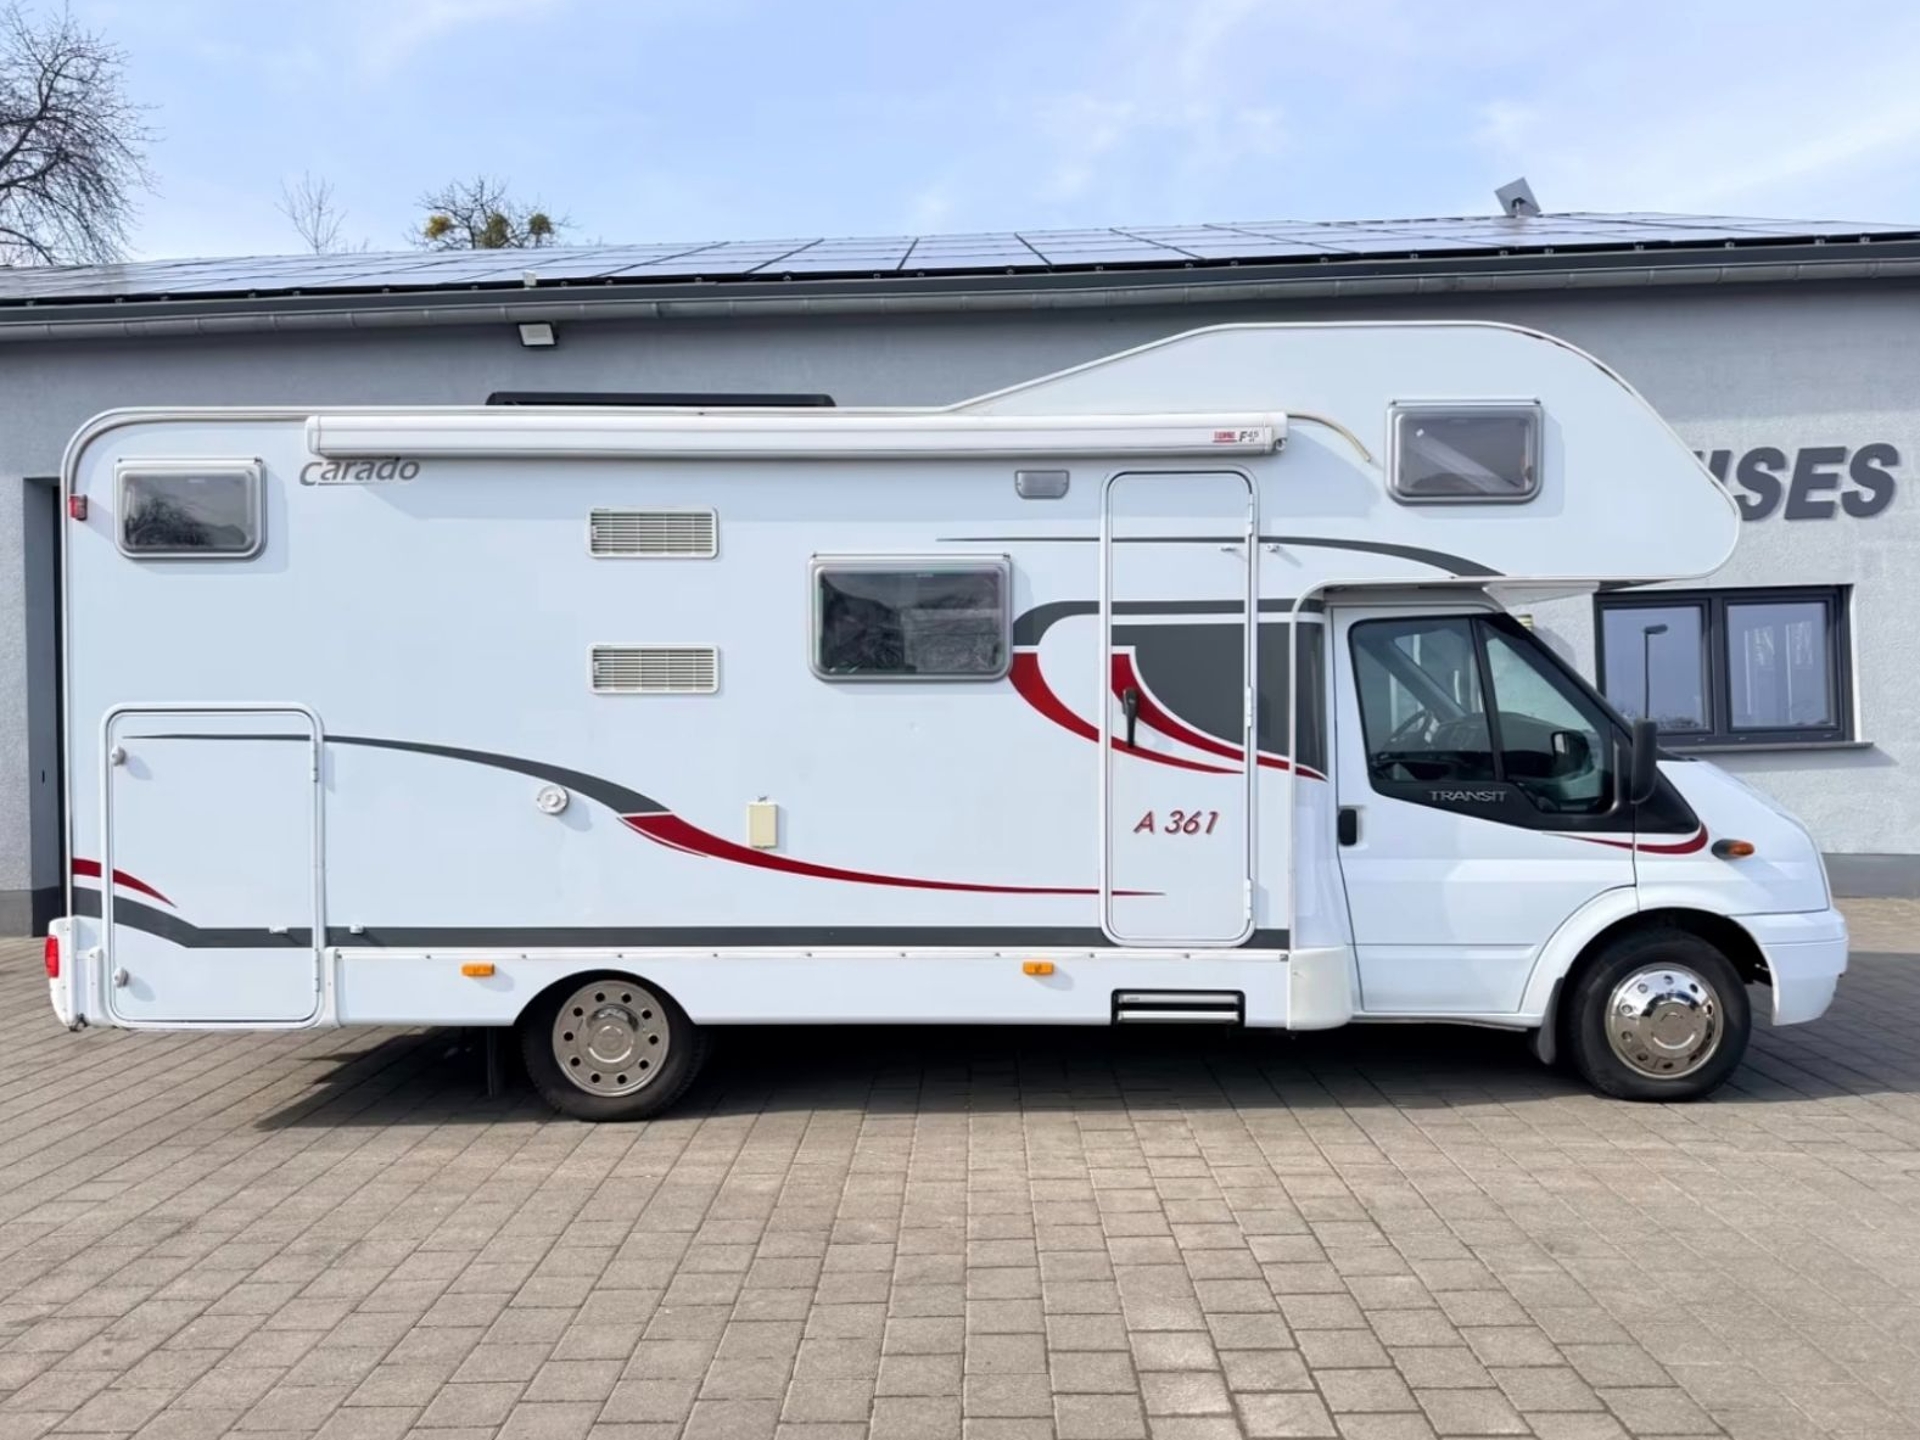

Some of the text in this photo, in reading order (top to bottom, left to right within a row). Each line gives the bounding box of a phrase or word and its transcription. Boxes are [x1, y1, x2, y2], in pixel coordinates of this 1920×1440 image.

[1430, 790, 1507, 802] TRANSIT
[1133, 809, 1219, 835] A 361
